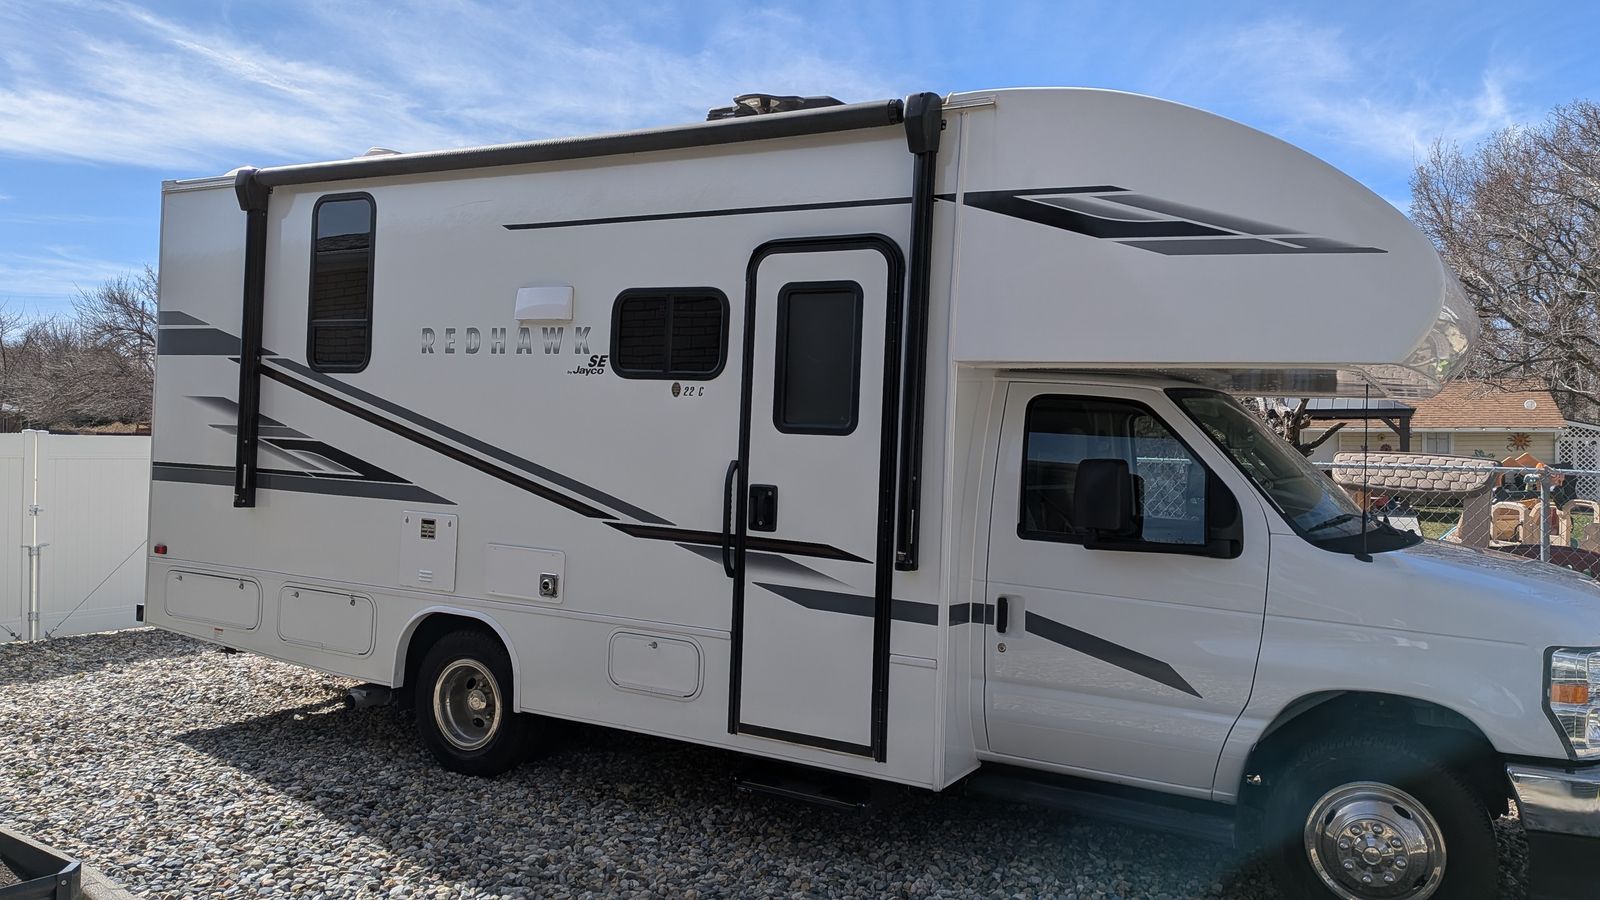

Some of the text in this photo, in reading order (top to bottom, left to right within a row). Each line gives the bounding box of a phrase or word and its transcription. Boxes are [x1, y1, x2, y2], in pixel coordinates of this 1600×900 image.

[421, 327, 591, 354] REDHAWK
[588, 354, 609, 367] SE
[573, 365, 604, 376] Jayco
[683, 386, 695, 397] 22
[698, 386, 704, 397] C
